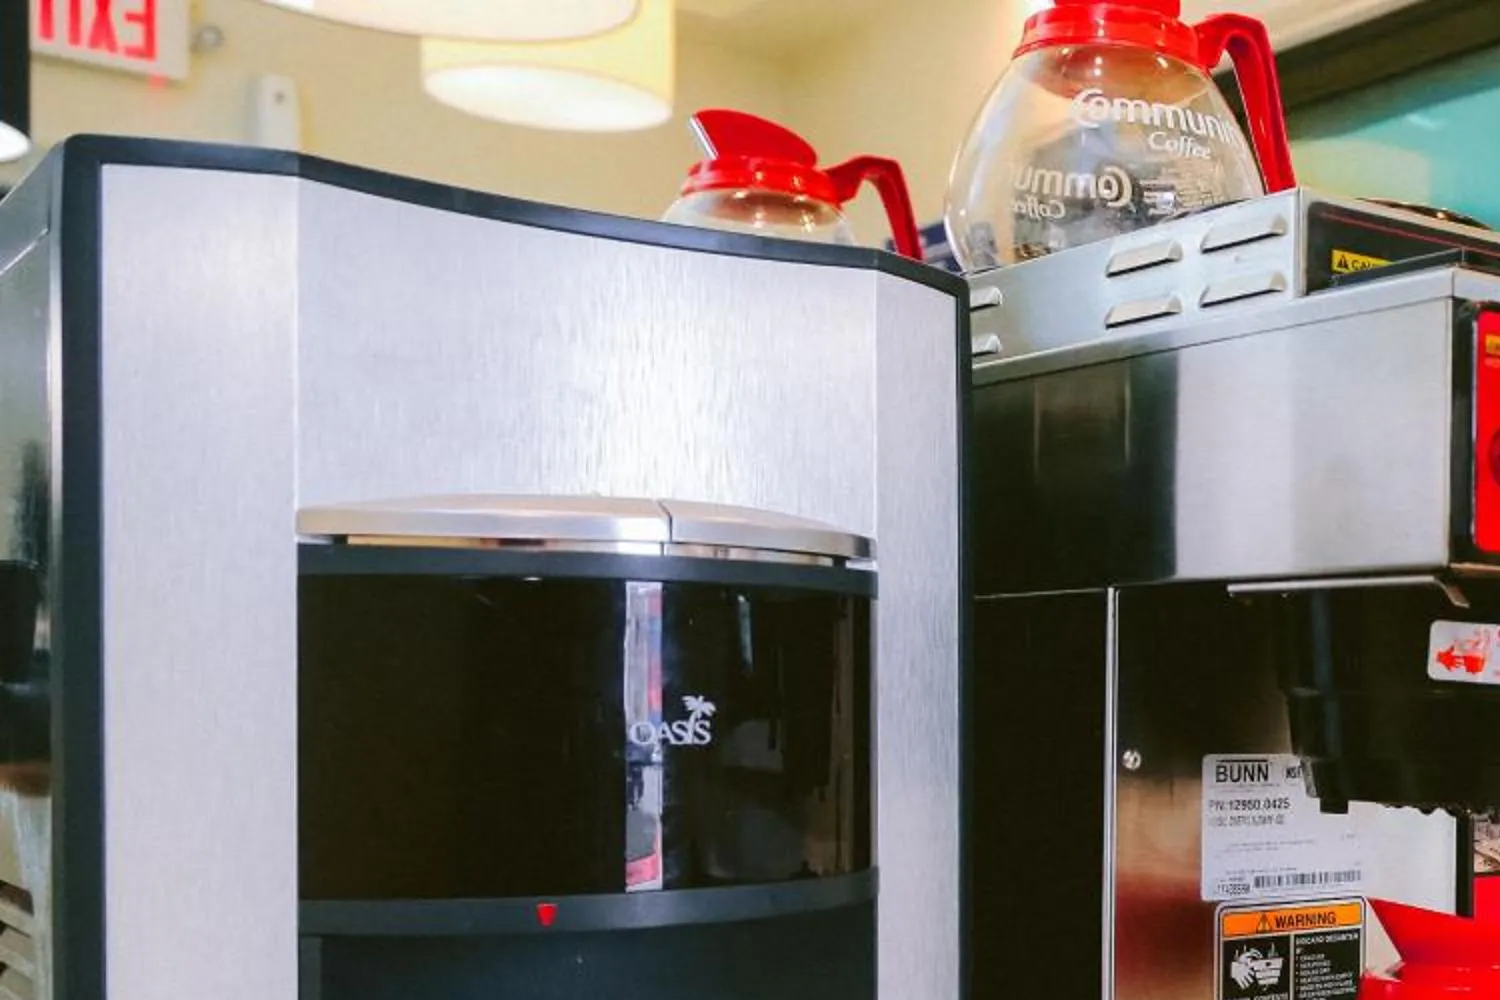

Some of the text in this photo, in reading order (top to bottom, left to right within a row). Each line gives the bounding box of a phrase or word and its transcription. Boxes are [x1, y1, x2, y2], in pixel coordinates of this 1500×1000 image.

[1148, 131, 1211, 159] Coffee
[630, 707, 714, 745] OASIS
[1215, 763, 1269, 783] BUNN
[1275, 911, 1337, 929] WARNING
